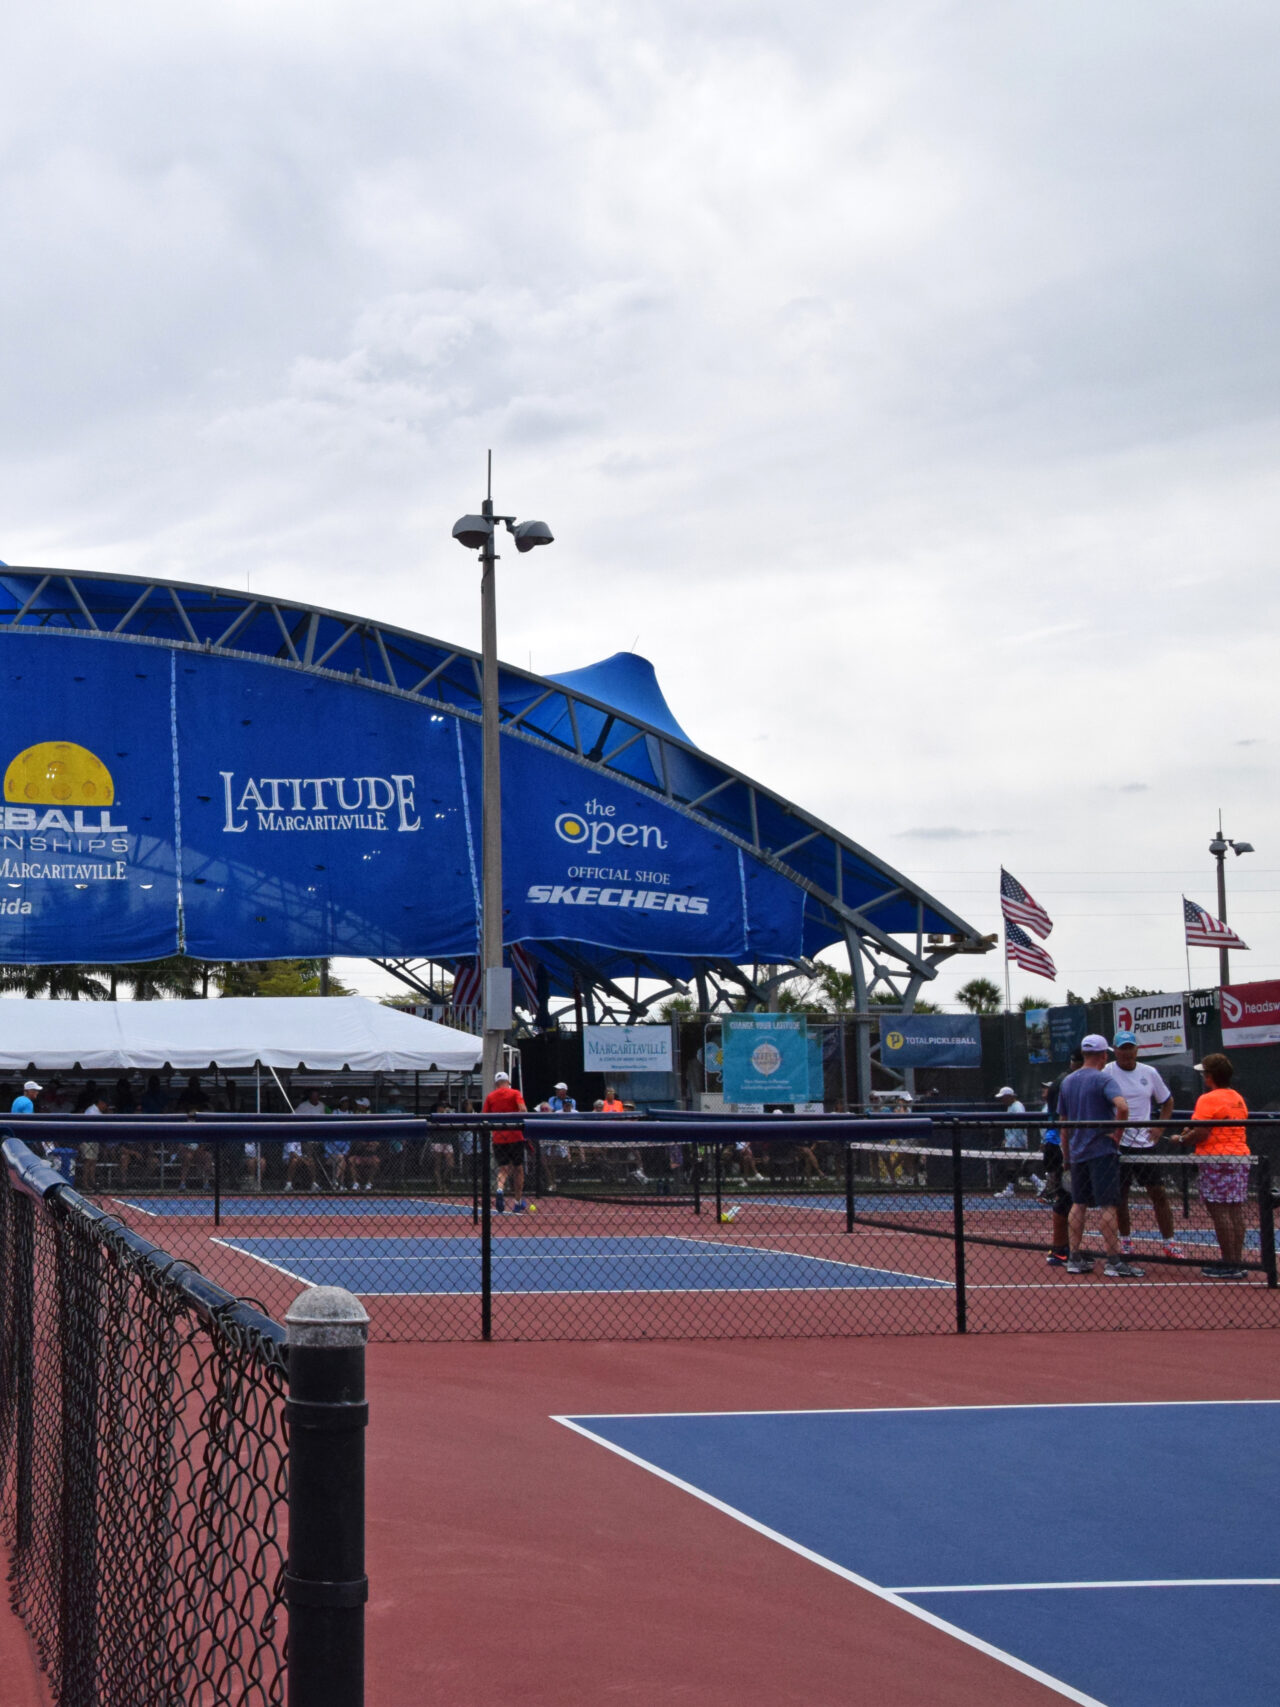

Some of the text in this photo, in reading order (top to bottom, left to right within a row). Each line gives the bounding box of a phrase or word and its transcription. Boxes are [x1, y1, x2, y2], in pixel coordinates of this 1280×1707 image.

[219, 771, 421, 833] LATITUDE
[585, 798, 617, 817] the
[257, 811, 389, 832] MARGARITAVILLE
[554, 812, 668, 855] Open
[567, 866, 671, 885] OFFICIAL SHOE
[525, 885, 710, 916] SKECHERS
[1188, 994, 1214, 1009] Court
[1133, 1004, 1183, 1022] GAMMA
[1195, 1011, 1207, 1025] 27
[1133, 1020, 1182, 1034] PICKLEBALL
[588, 1041, 667, 1055] MARGARITAVILLE
[905, 1036, 977, 1045] TOTALPICKLEBALL
